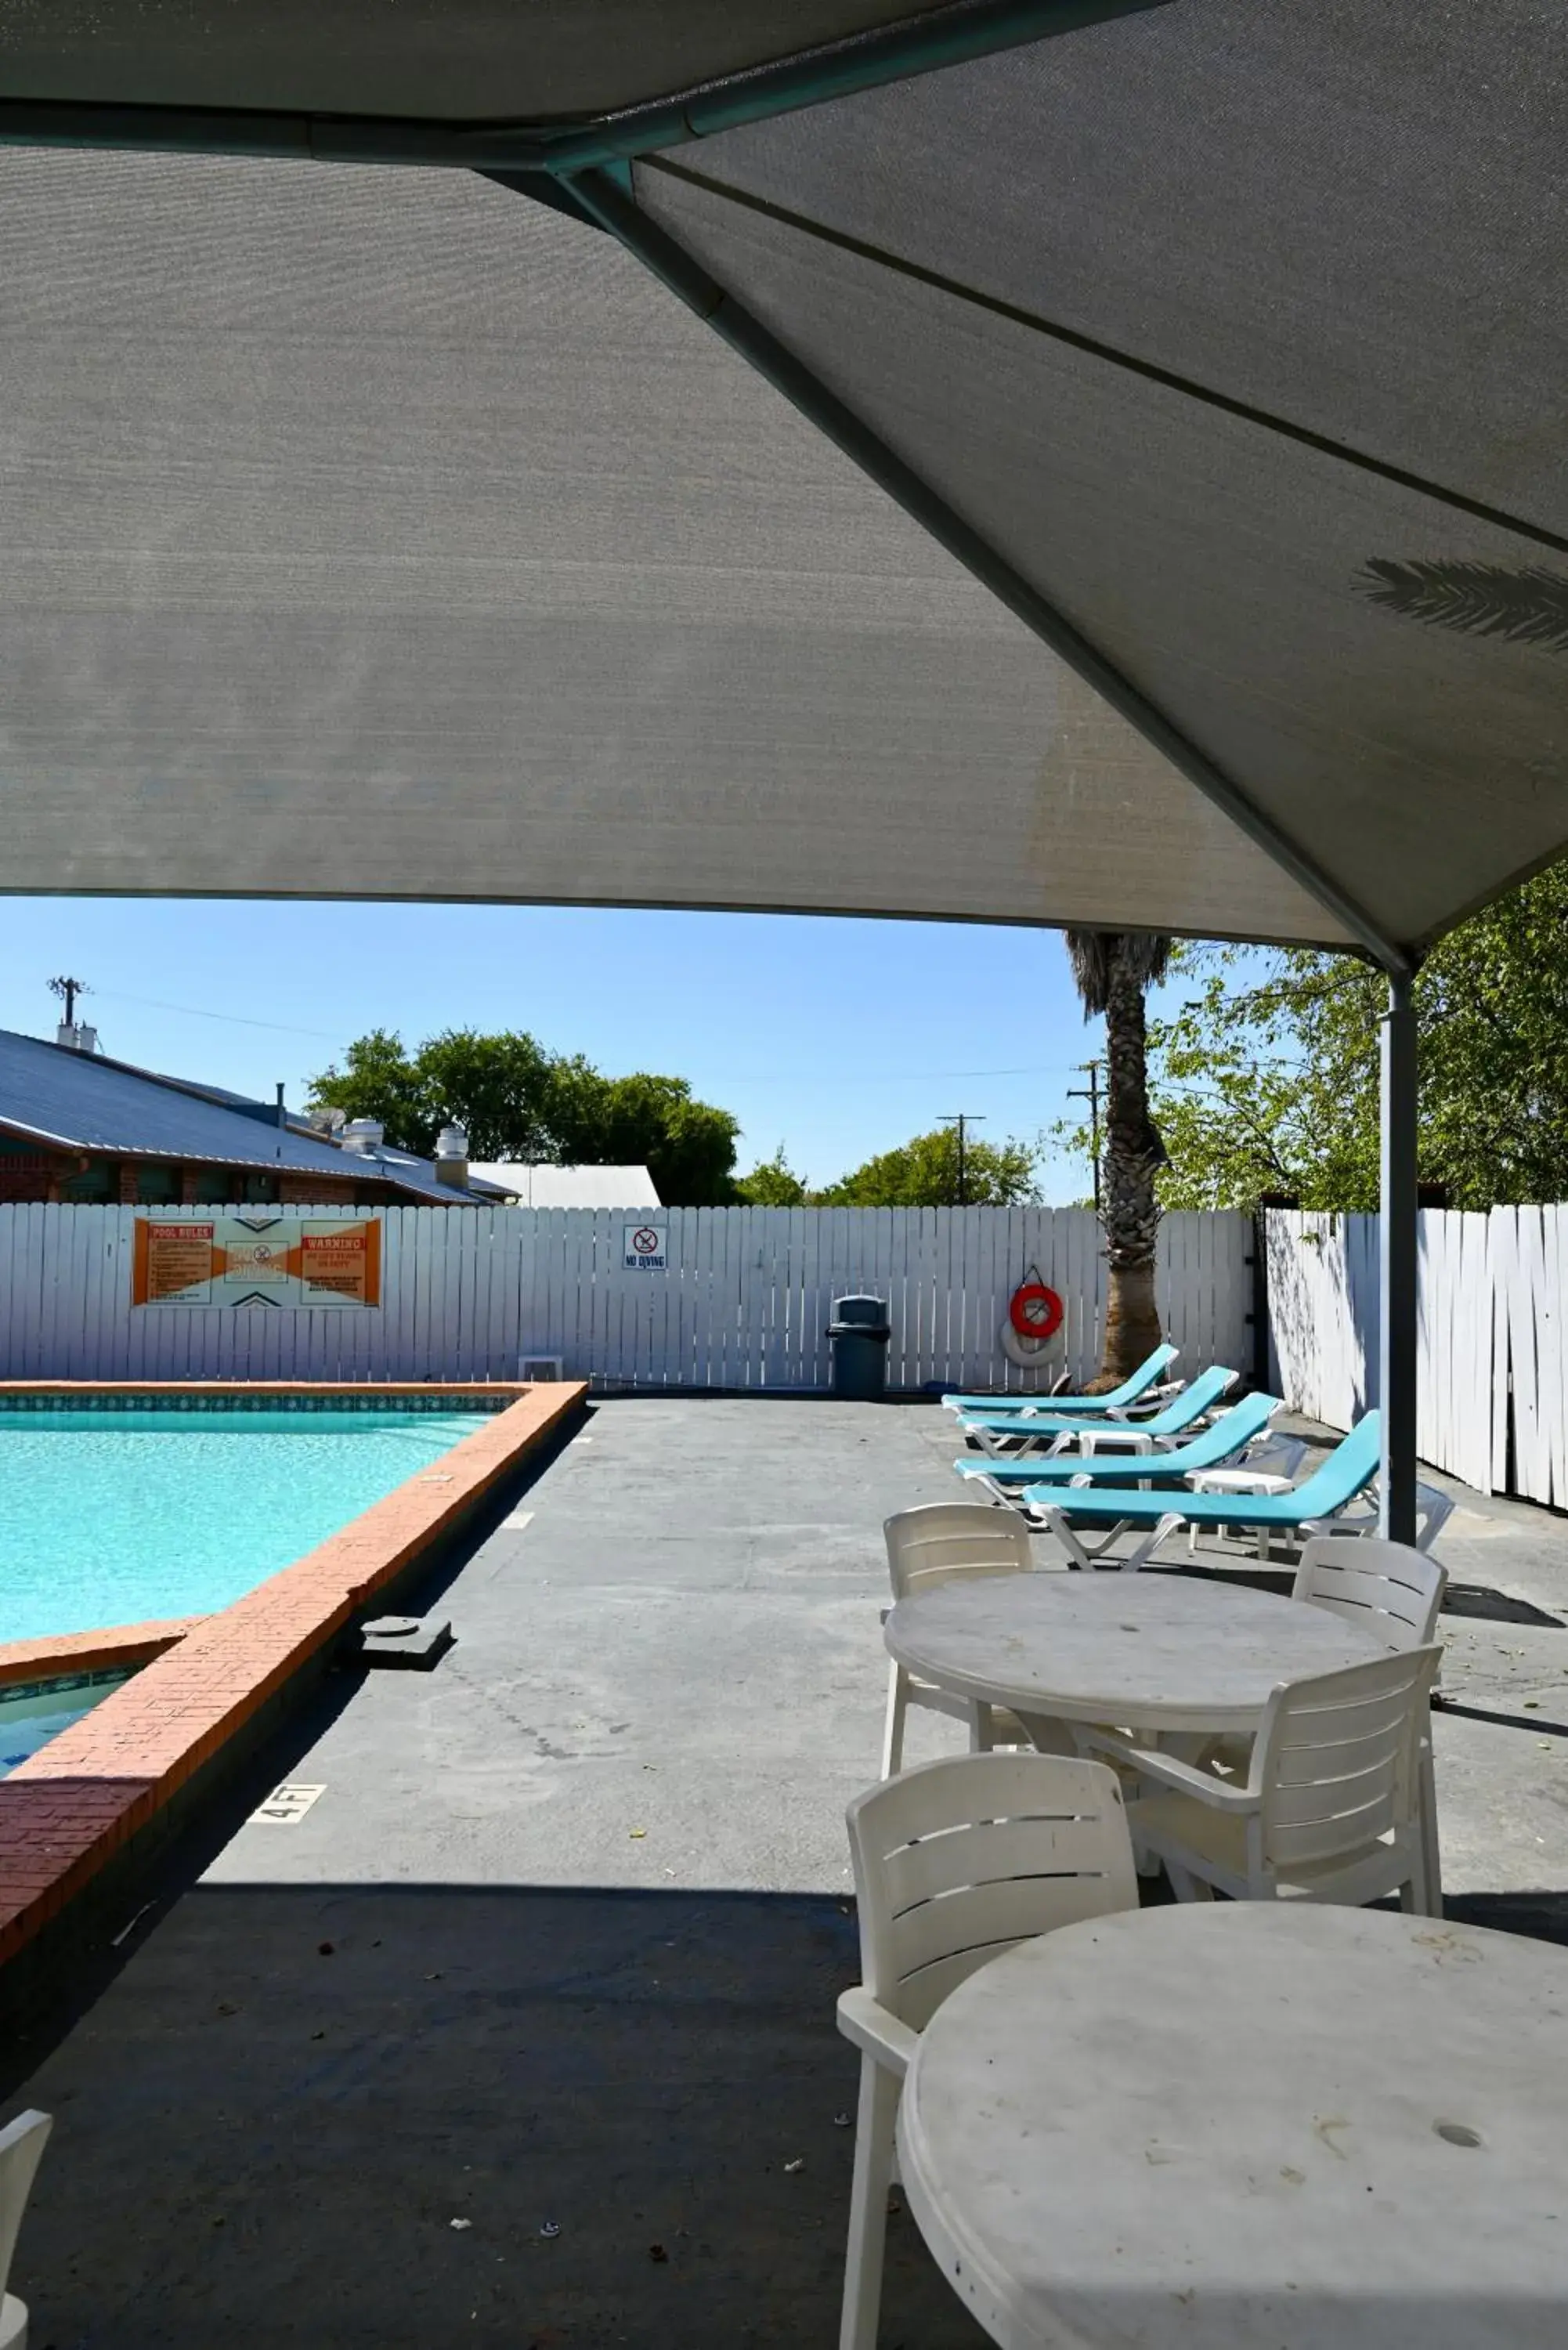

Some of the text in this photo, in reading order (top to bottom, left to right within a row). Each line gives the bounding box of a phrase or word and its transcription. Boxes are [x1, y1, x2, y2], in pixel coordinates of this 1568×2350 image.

[153, 1227, 209, 1238] POOL RULES
[308, 1238, 361, 1249] WARNING
[626, 1255, 665, 1267] NO DIVING
[260, 1785, 317, 1818] 4 FT
